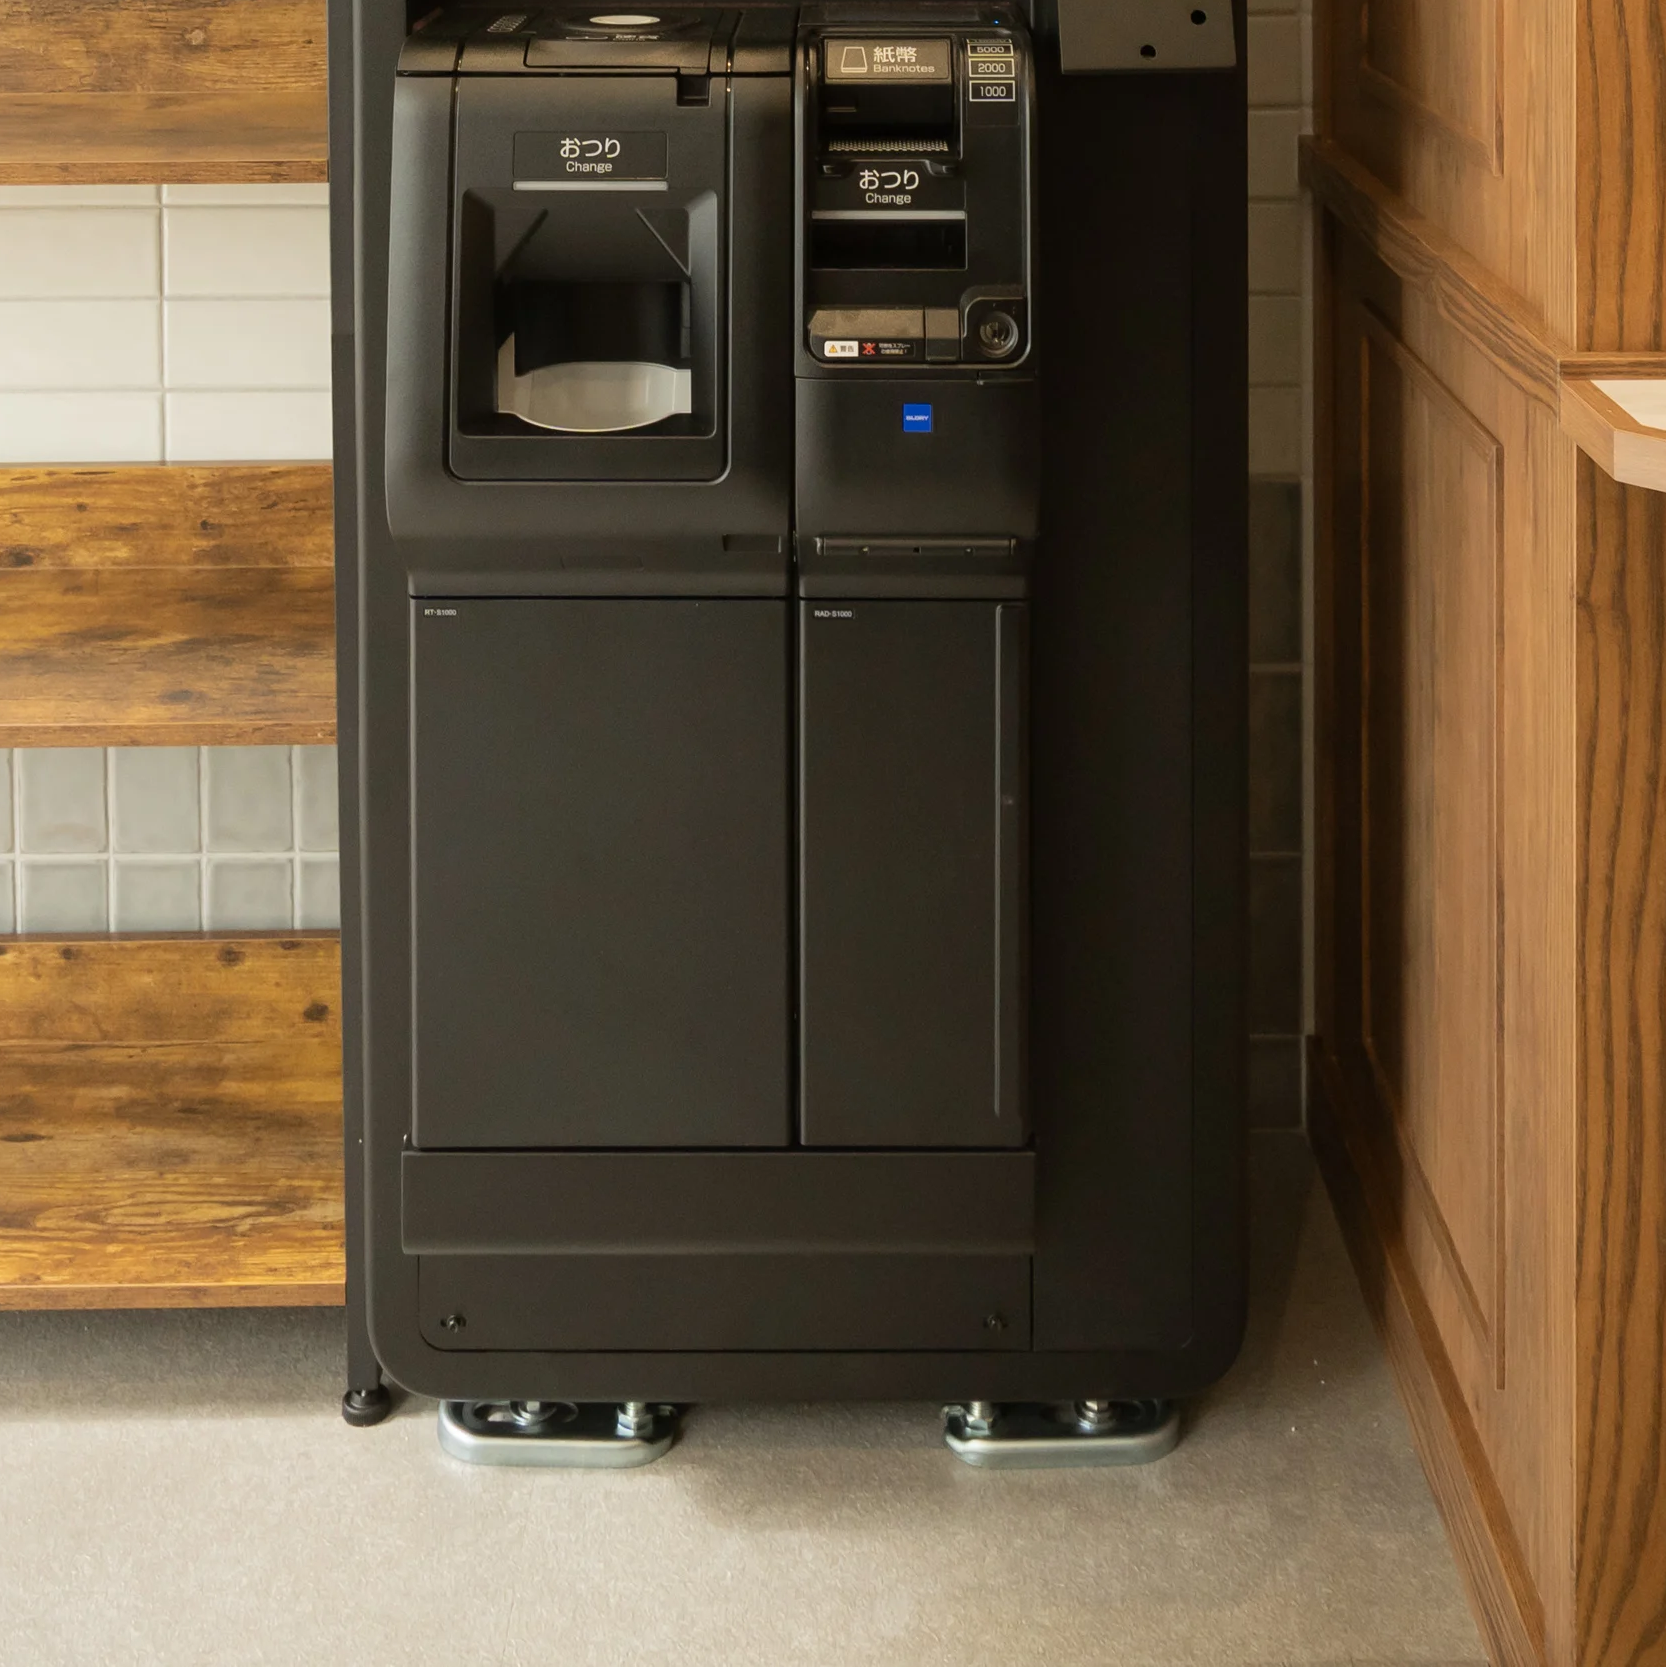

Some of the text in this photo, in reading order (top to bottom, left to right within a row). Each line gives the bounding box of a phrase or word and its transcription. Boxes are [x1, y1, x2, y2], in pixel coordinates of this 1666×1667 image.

[873, 46, 918, 63] 紙幣
[873, 64, 935, 73] Banknotes
[977, 63, 1006, 73] 2000
[979, 86, 1007, 97] 1000
[559, 137, 621, 158] おつり
[566, 161, 613, 173] Change
[859, 169, 920, 190] おつり
[865, 192, 912, 205] Change
